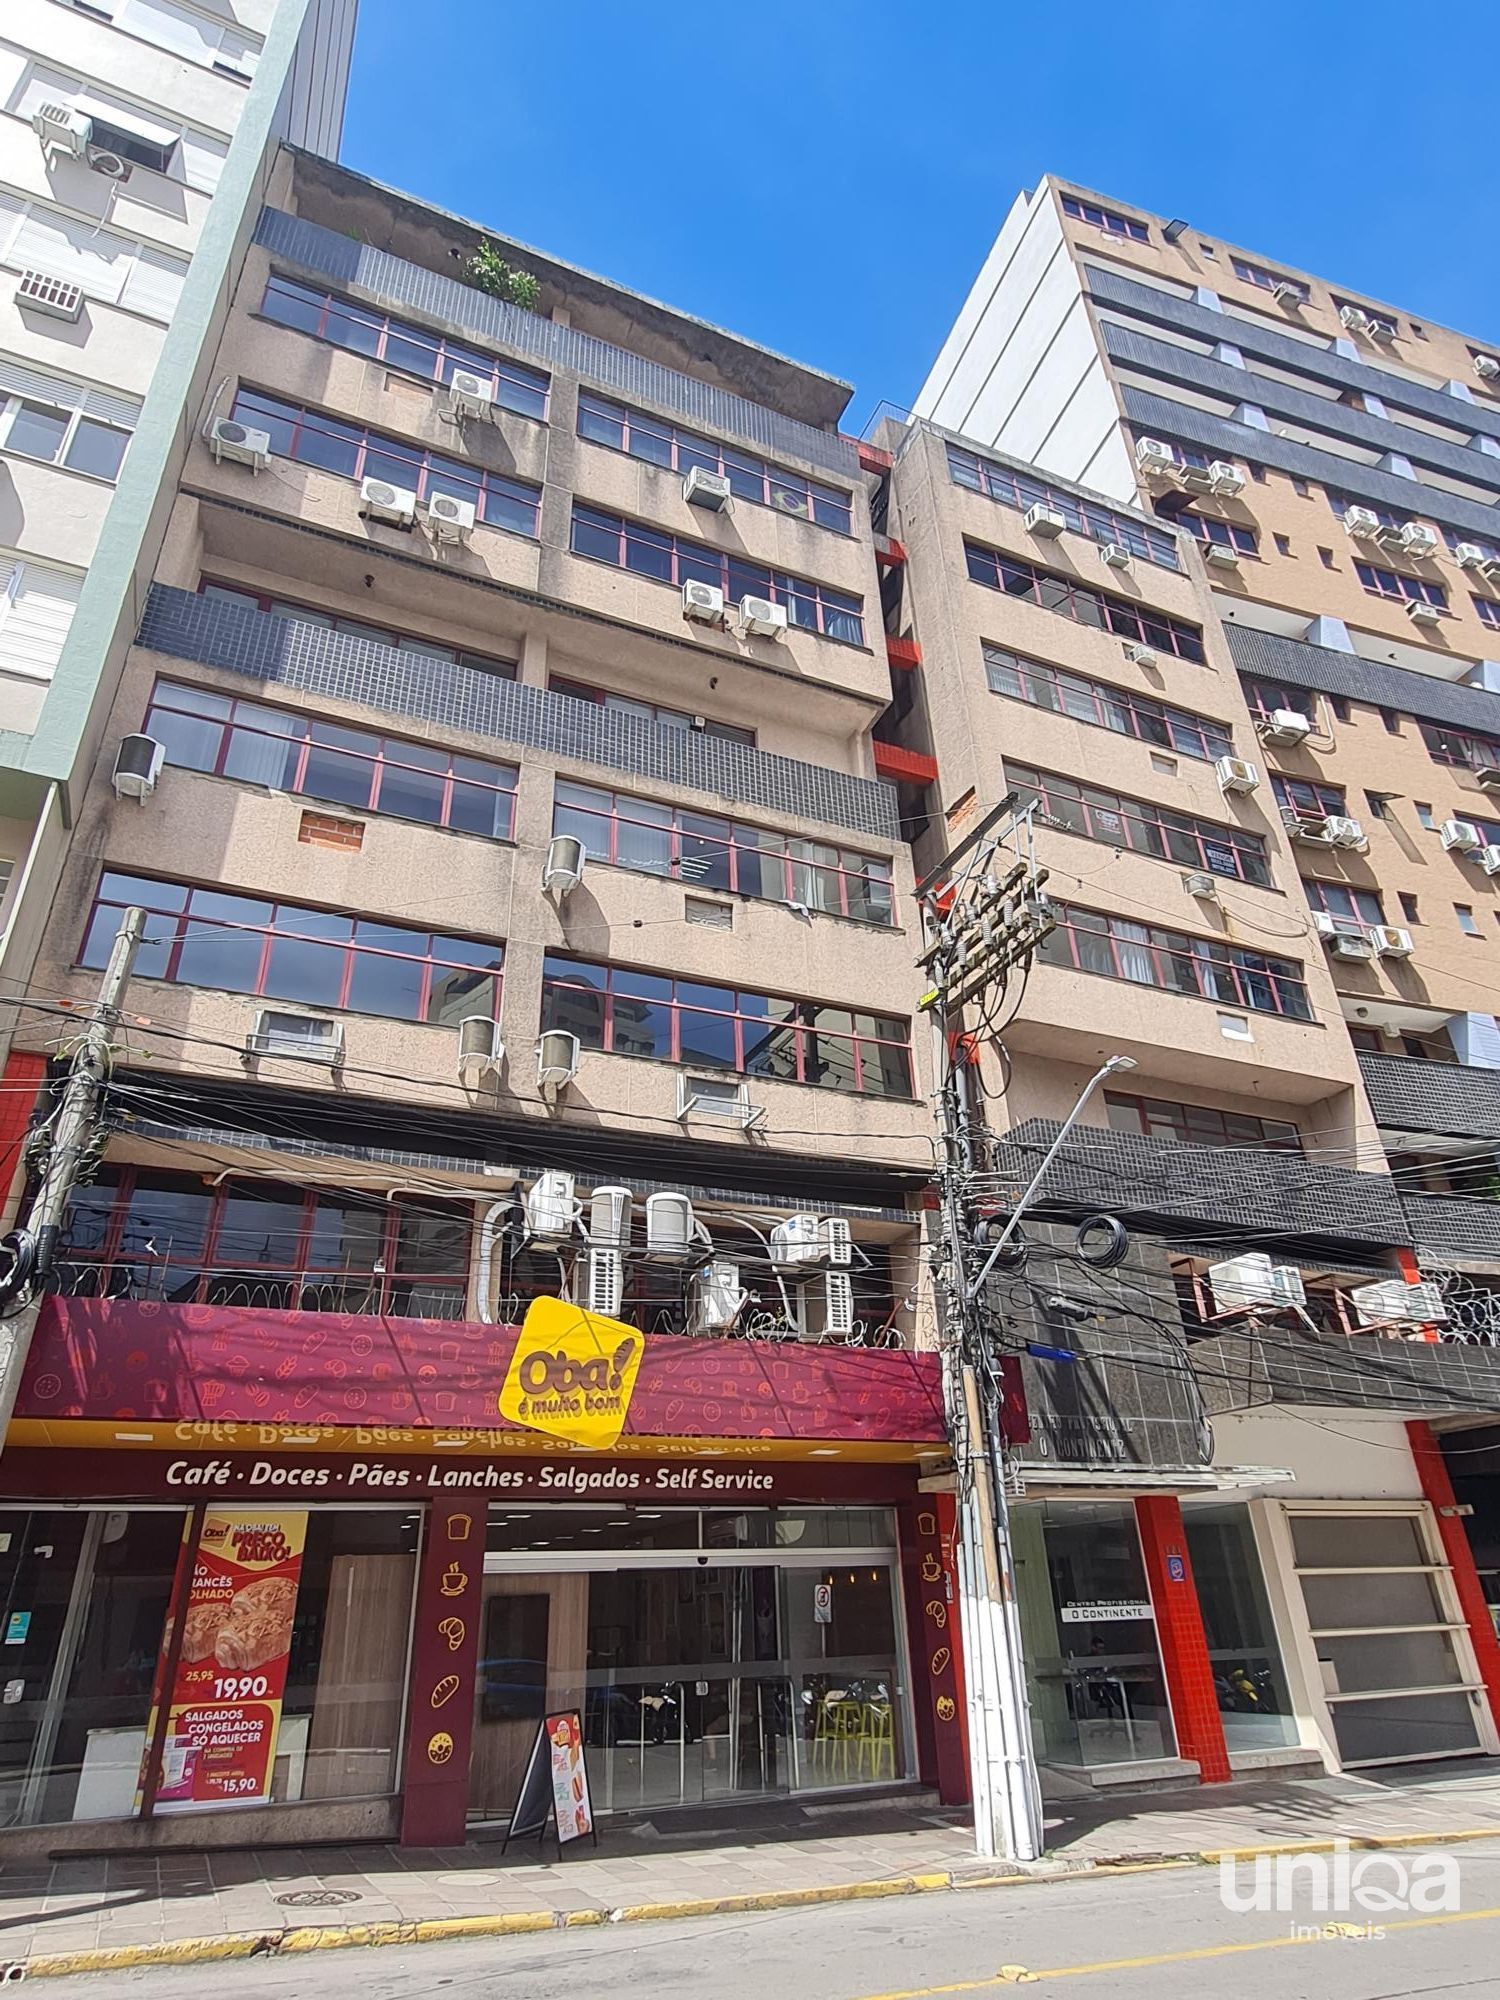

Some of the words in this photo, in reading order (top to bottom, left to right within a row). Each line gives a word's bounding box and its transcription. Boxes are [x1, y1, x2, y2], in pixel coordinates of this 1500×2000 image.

[520, 1337, 636, 1395] Oba!
[532, 1395, 580, 1414] muito
[585, 1393, 621, 1410] bom
[166, 1461, 232, 1486] Café
[249, 1461, 331, 1486] Doces
[348, 1463, 410, 1487] Pães
[427, 1465, 524, 1488] Lanches
[538, 1466, 640, 1494] Salgados
[655, 1468, 698, 1489] Self
[700, 1468, 774, 1490] Service
[204, 1524, 231, 1538] Oba!
[190, 1589, 234, 1600] OLHADO
[1072, 1610, 1079, 1619] O
[1082, 1608, 1144, 1619] CONTINENTE
[185, 1670, 214, 1682] 25,95
[214, 1676, 268, 1701] 19,90
[185, 1709, 244, 1723] SALGADOS
[188, 1720, 264, 1734] CONGELADOS
[192, 1731, 208, 1746] SÓ
[210, 1732, 261, 1745] AQUECER
[223, 1777, 257, 1793] 15,90
